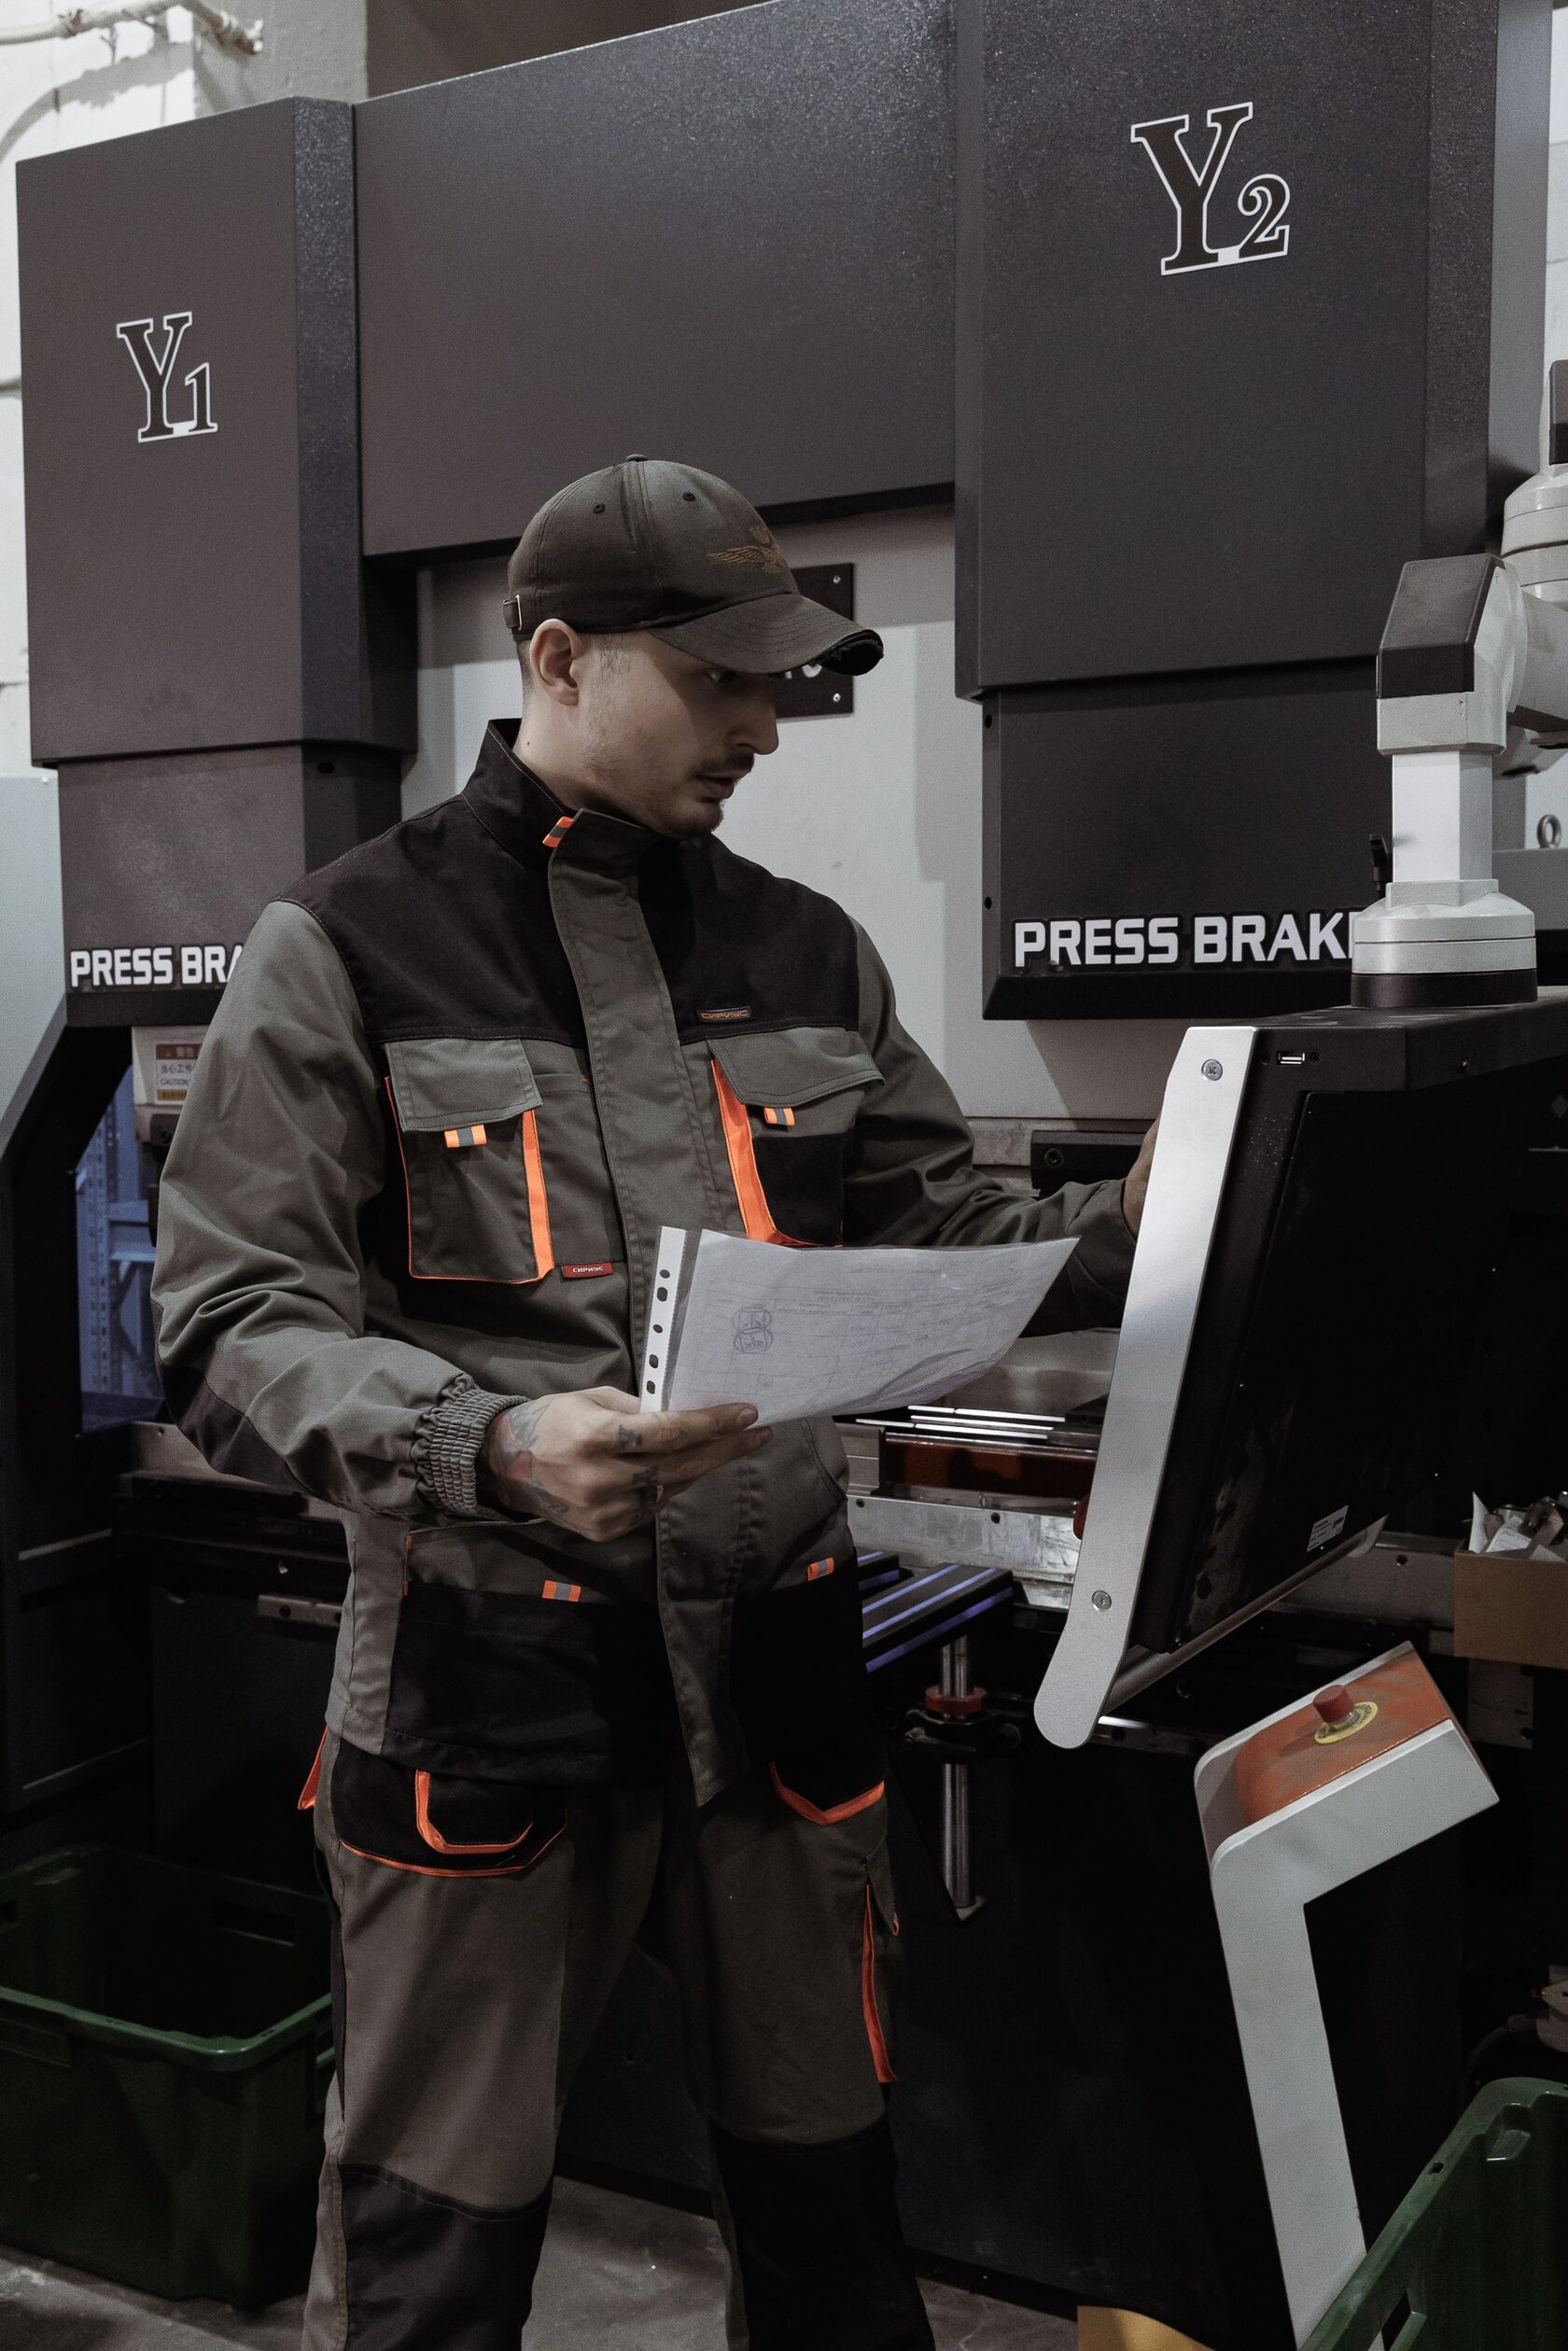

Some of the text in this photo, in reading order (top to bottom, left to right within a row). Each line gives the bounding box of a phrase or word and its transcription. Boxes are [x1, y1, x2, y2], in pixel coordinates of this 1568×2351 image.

[1130, 101, 1291, 276] Y2
[116, 311, 218, 443] Y1
[70, 946, 174, 987] PRESS
[1015, 917, 1179, 968] PRESS
